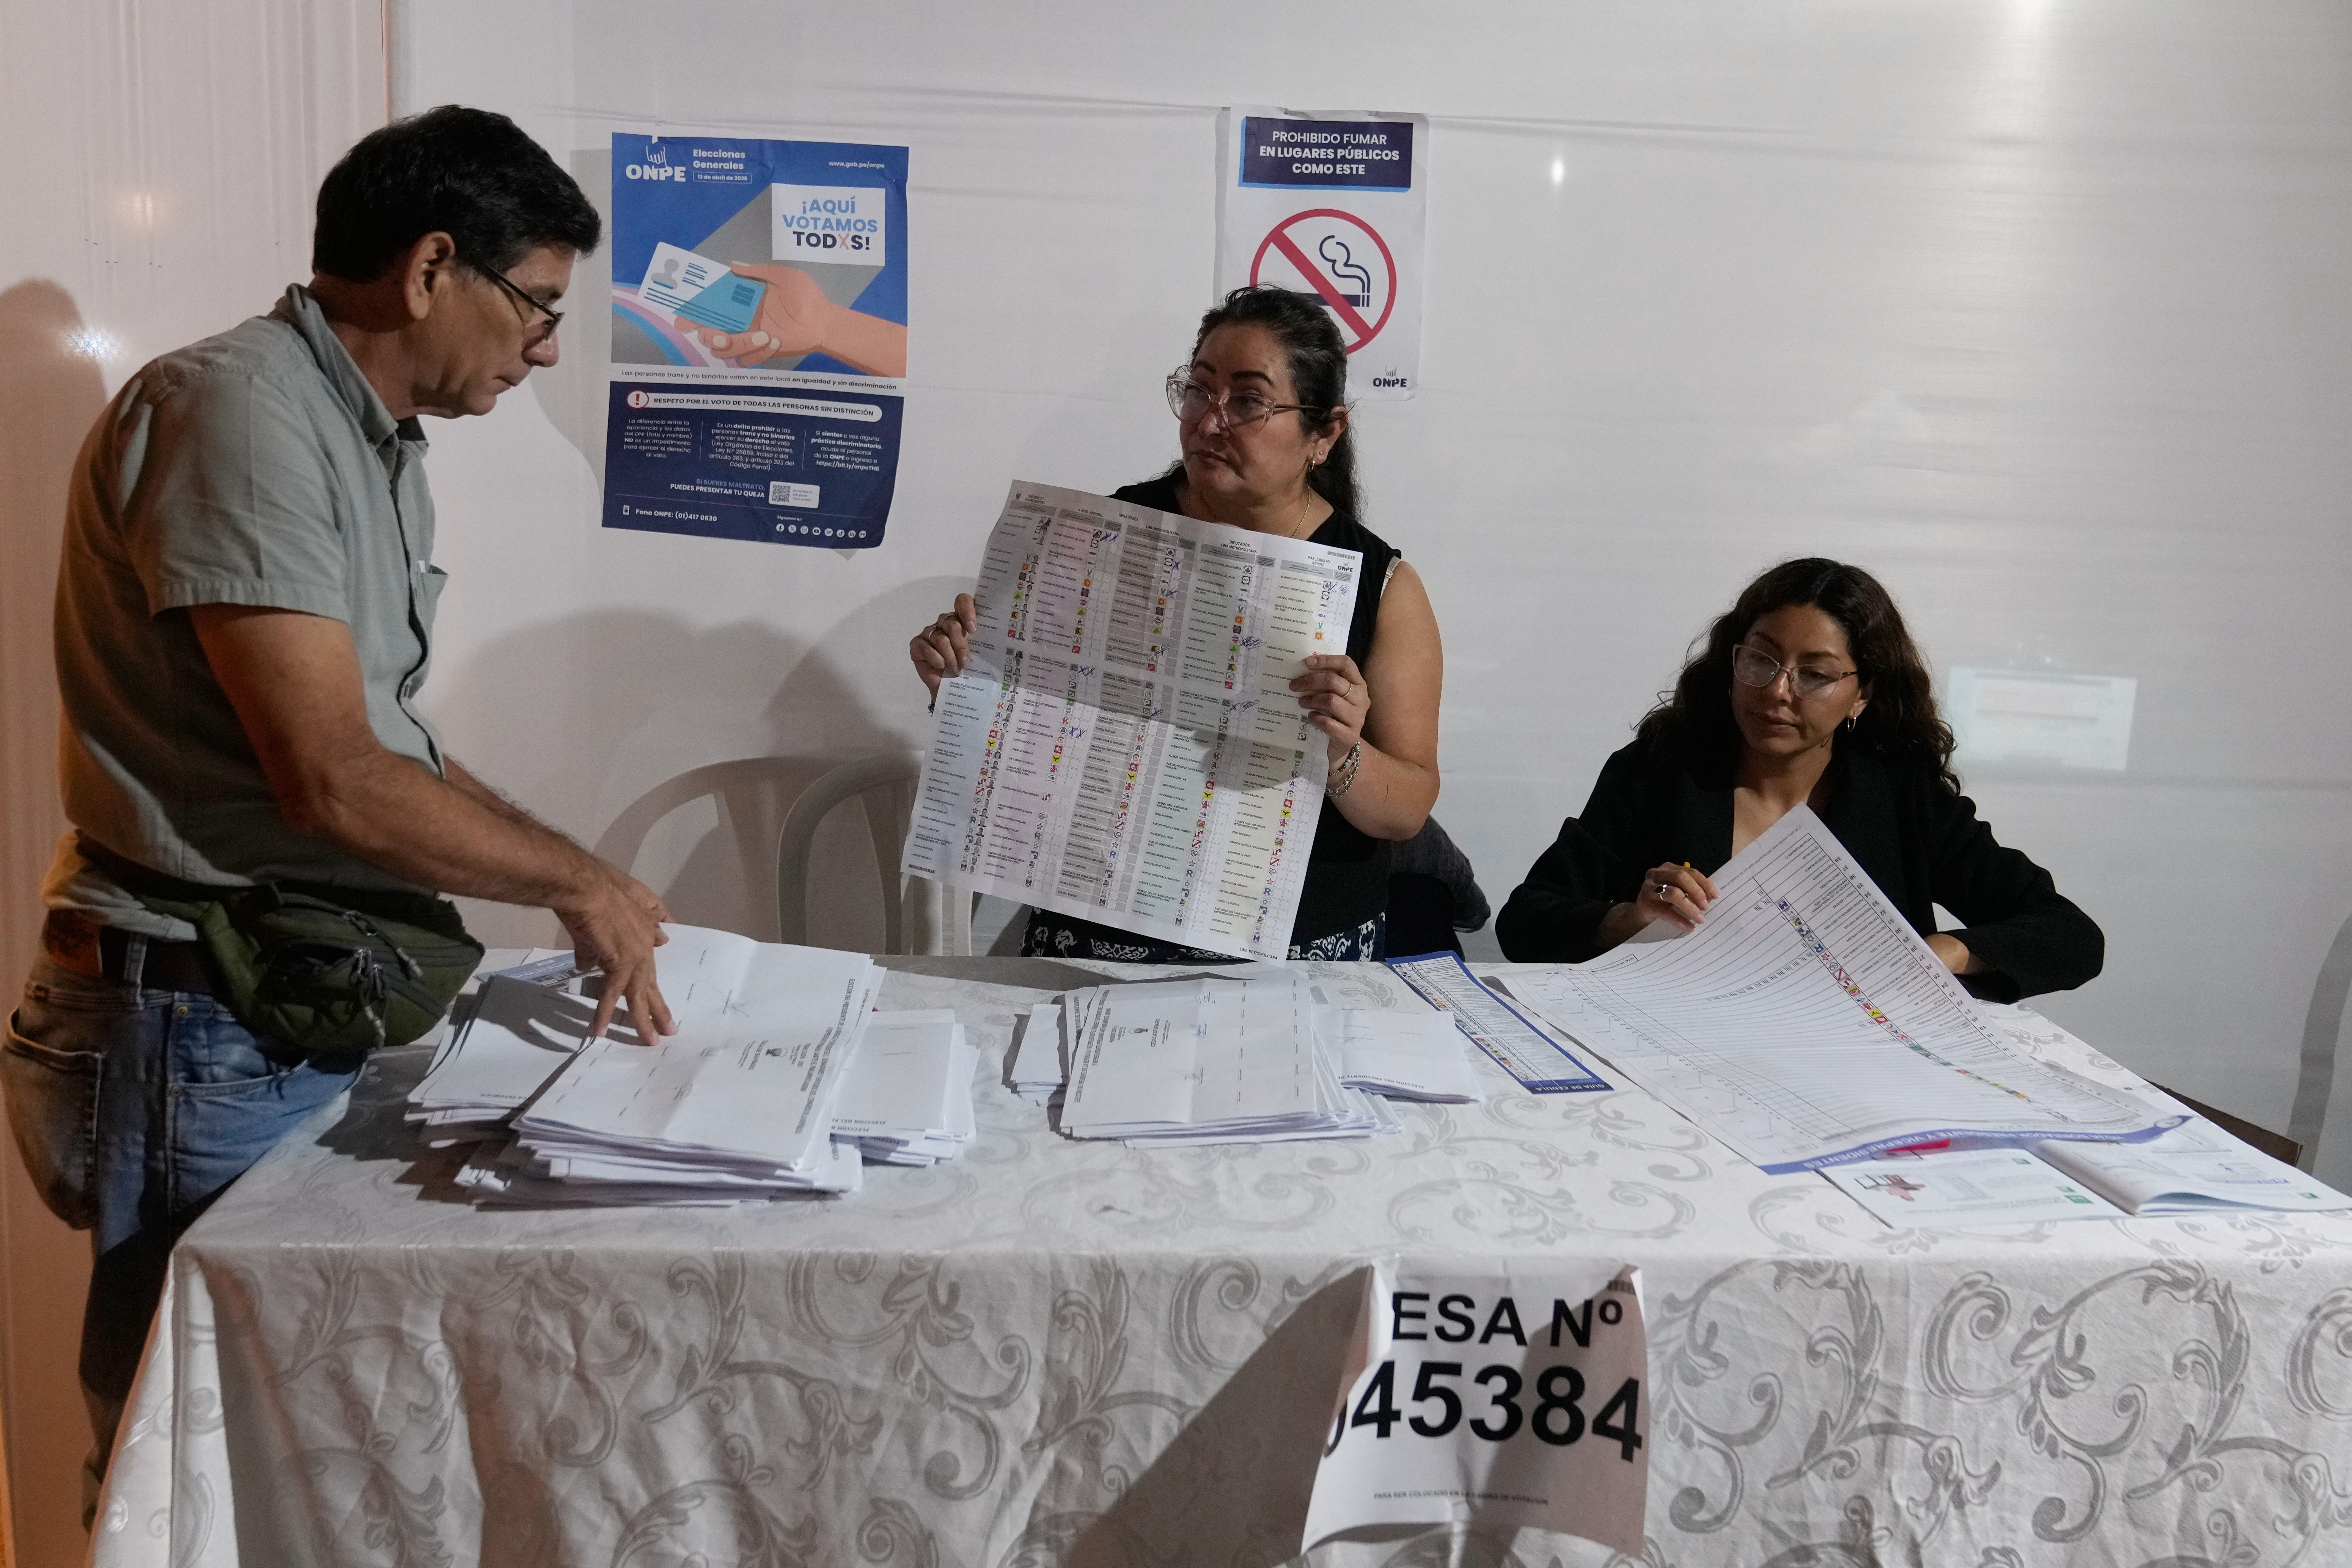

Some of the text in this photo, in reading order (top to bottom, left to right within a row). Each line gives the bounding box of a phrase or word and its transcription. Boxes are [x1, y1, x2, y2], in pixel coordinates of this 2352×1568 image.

[1273, 131, 1387, 145] PROHIBIDO FUMAR
[693, 149, 745, 159] Elecciones
[1260, 146, 1399, 161] EN LUGARES PÚBLICOS
[693, 160, 744, 170] Generales
[1292, 163, 1365, 175] COMO ESTE
[626, 165, 686, 182] ONPE
[802, 196, 855, 215] ¡AQUÍ
[782, 215, 878, 233] VOTAMOS
[793, 231, 870, 250] TODXS!
[849, 381, 896, 389] discriminación
[1373, 378, 1407, 388] ONPE
[834, 406, 873, 416] DISTINCIÓN
[837, 440, 882, 449] discriminatoria,
[816, 460, 879, 471] https://bit.ly/onpeTNB
[696, 486, 732, 495] PRESENTAR
[728, 482, 765, 491] MALTRATO,
[675, 511, 699, 521] (01)417
[1153, 527, 1179, 536] METROPOLITANA
[1229, 545, 1257, 553] METROPOLITANA
[1308, 555, 1330, 564] PARLAMENTO
[1249, 950, 1277, 960] METROPOLITANA
[1550, 1298, 1623, 1348] Nº
